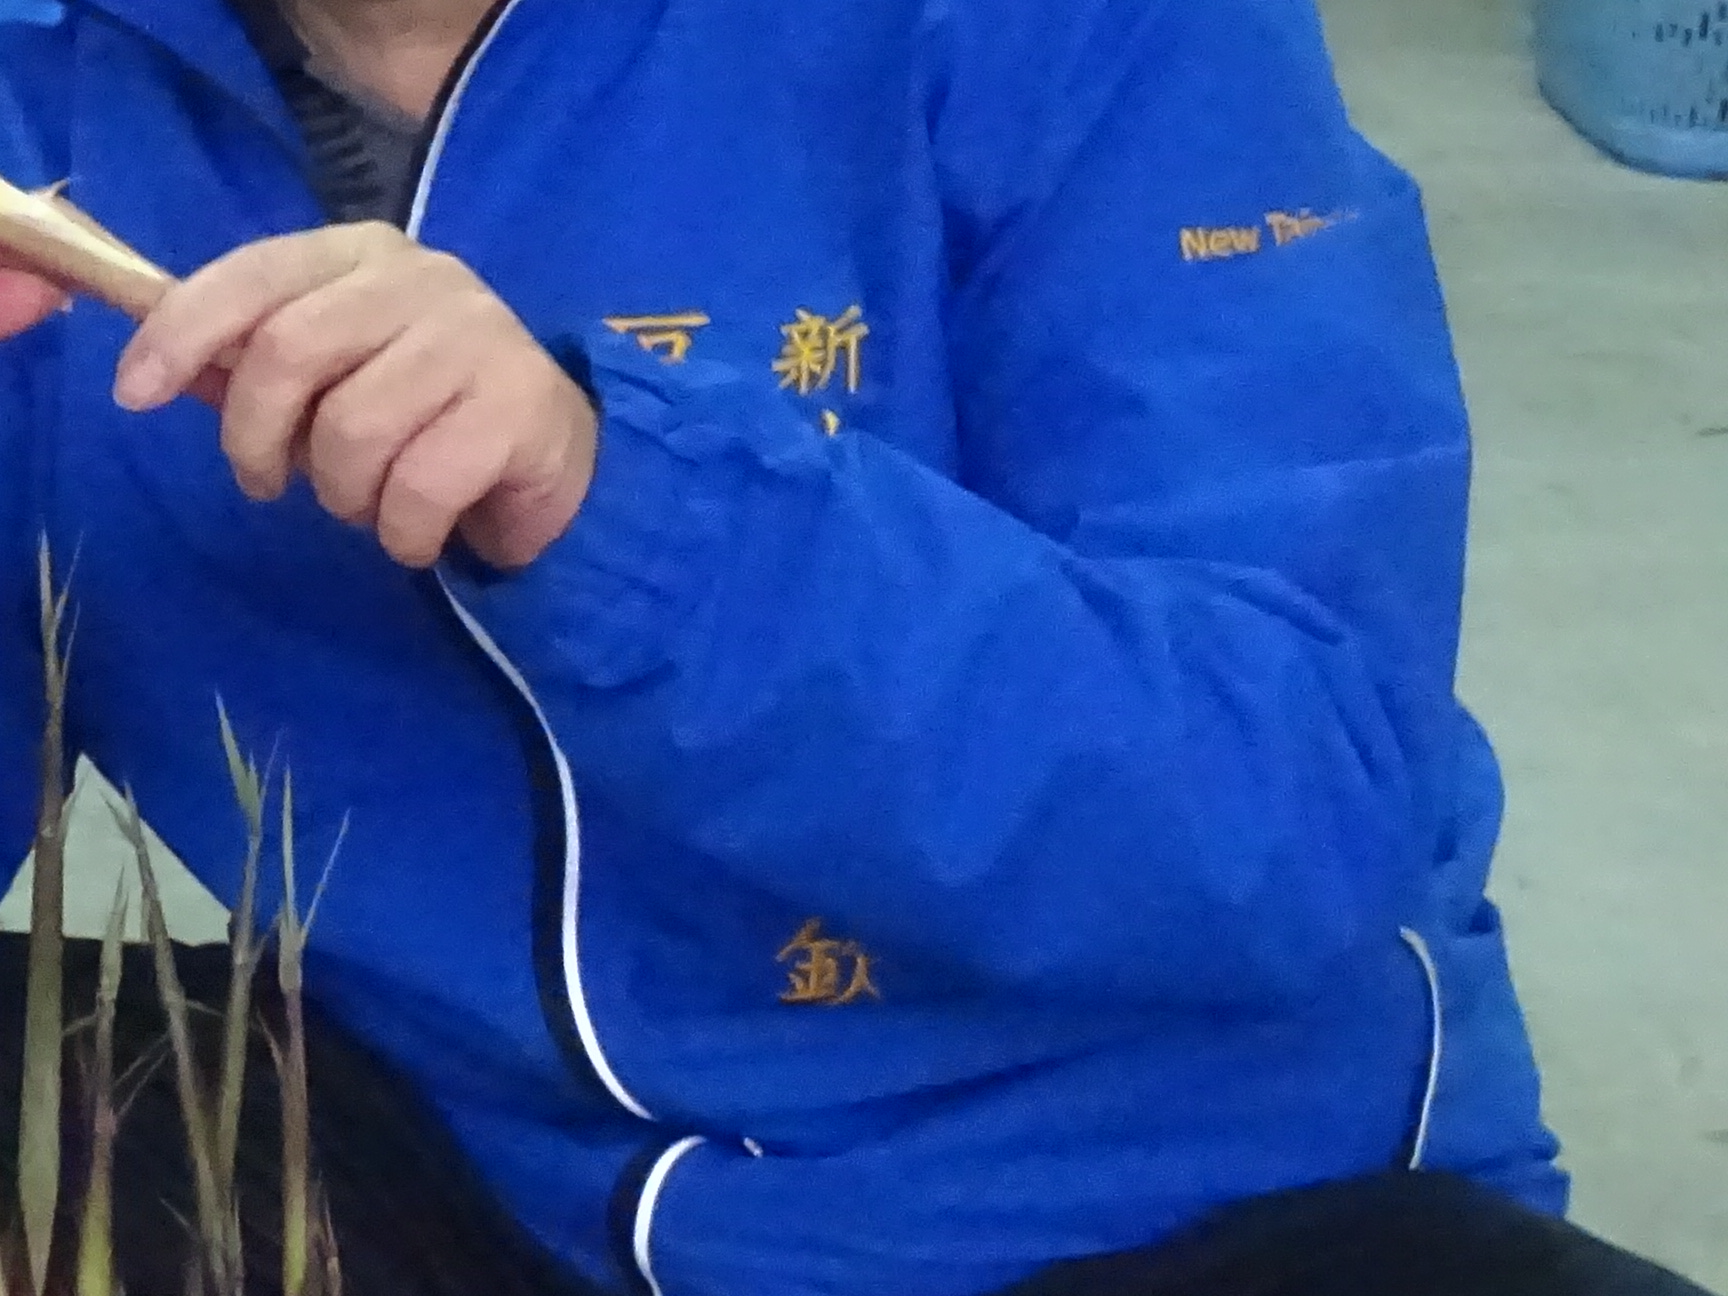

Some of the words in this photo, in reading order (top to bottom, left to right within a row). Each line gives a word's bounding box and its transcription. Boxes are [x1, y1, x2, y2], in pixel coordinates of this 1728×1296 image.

[1180, 225, 1262, 261] New
[1263, 207, 1360, 247] Tai
[771, 303, 871, 437] 新
